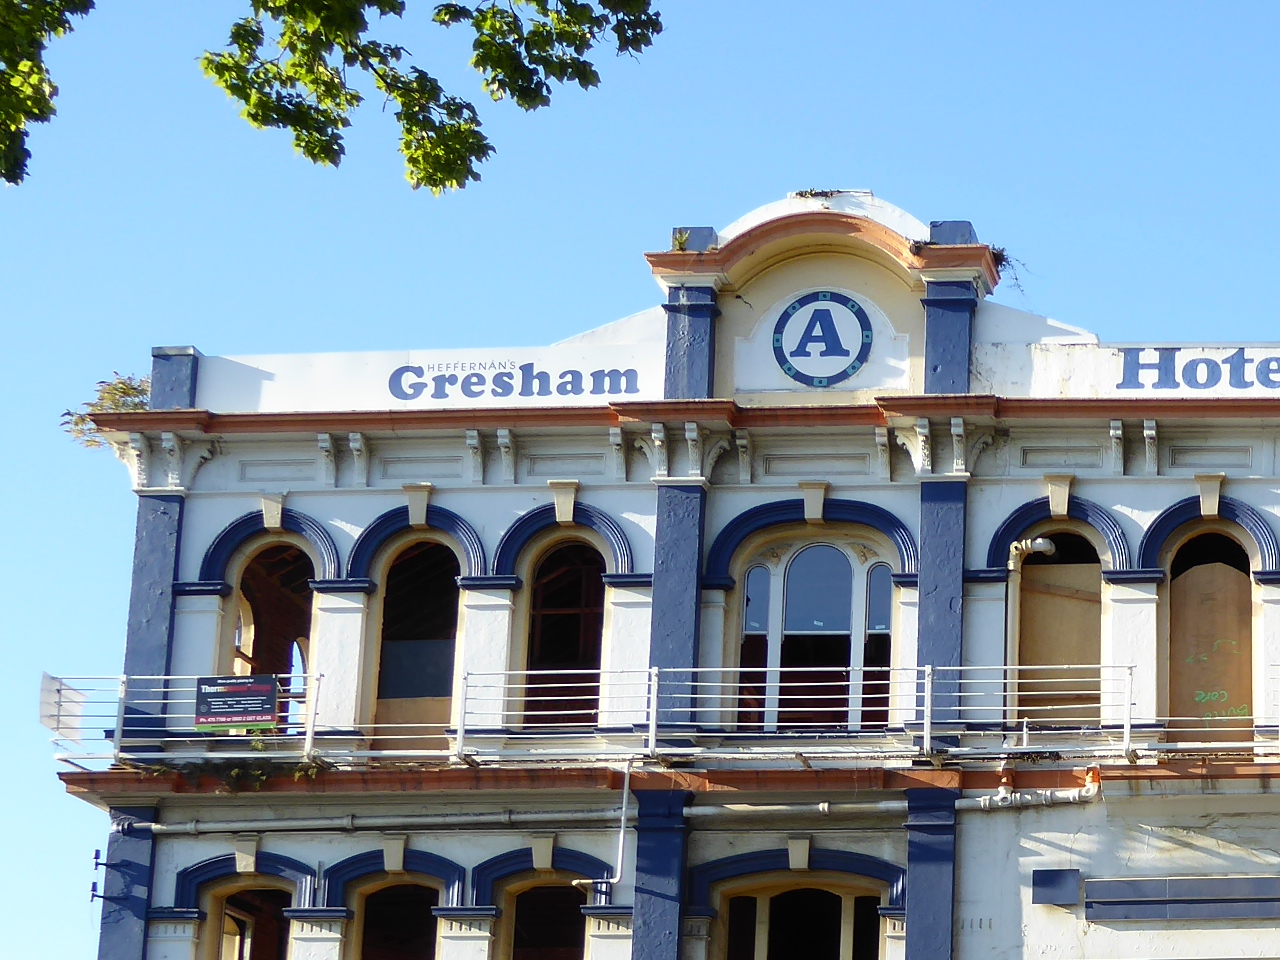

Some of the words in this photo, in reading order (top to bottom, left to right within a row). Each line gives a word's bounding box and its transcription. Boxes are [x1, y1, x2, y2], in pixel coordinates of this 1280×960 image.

[789, 308, 851, 358] A
[388, 362, 640, 401] Gresham
[426, 358, 517, 373] HEFFERNAN'S
